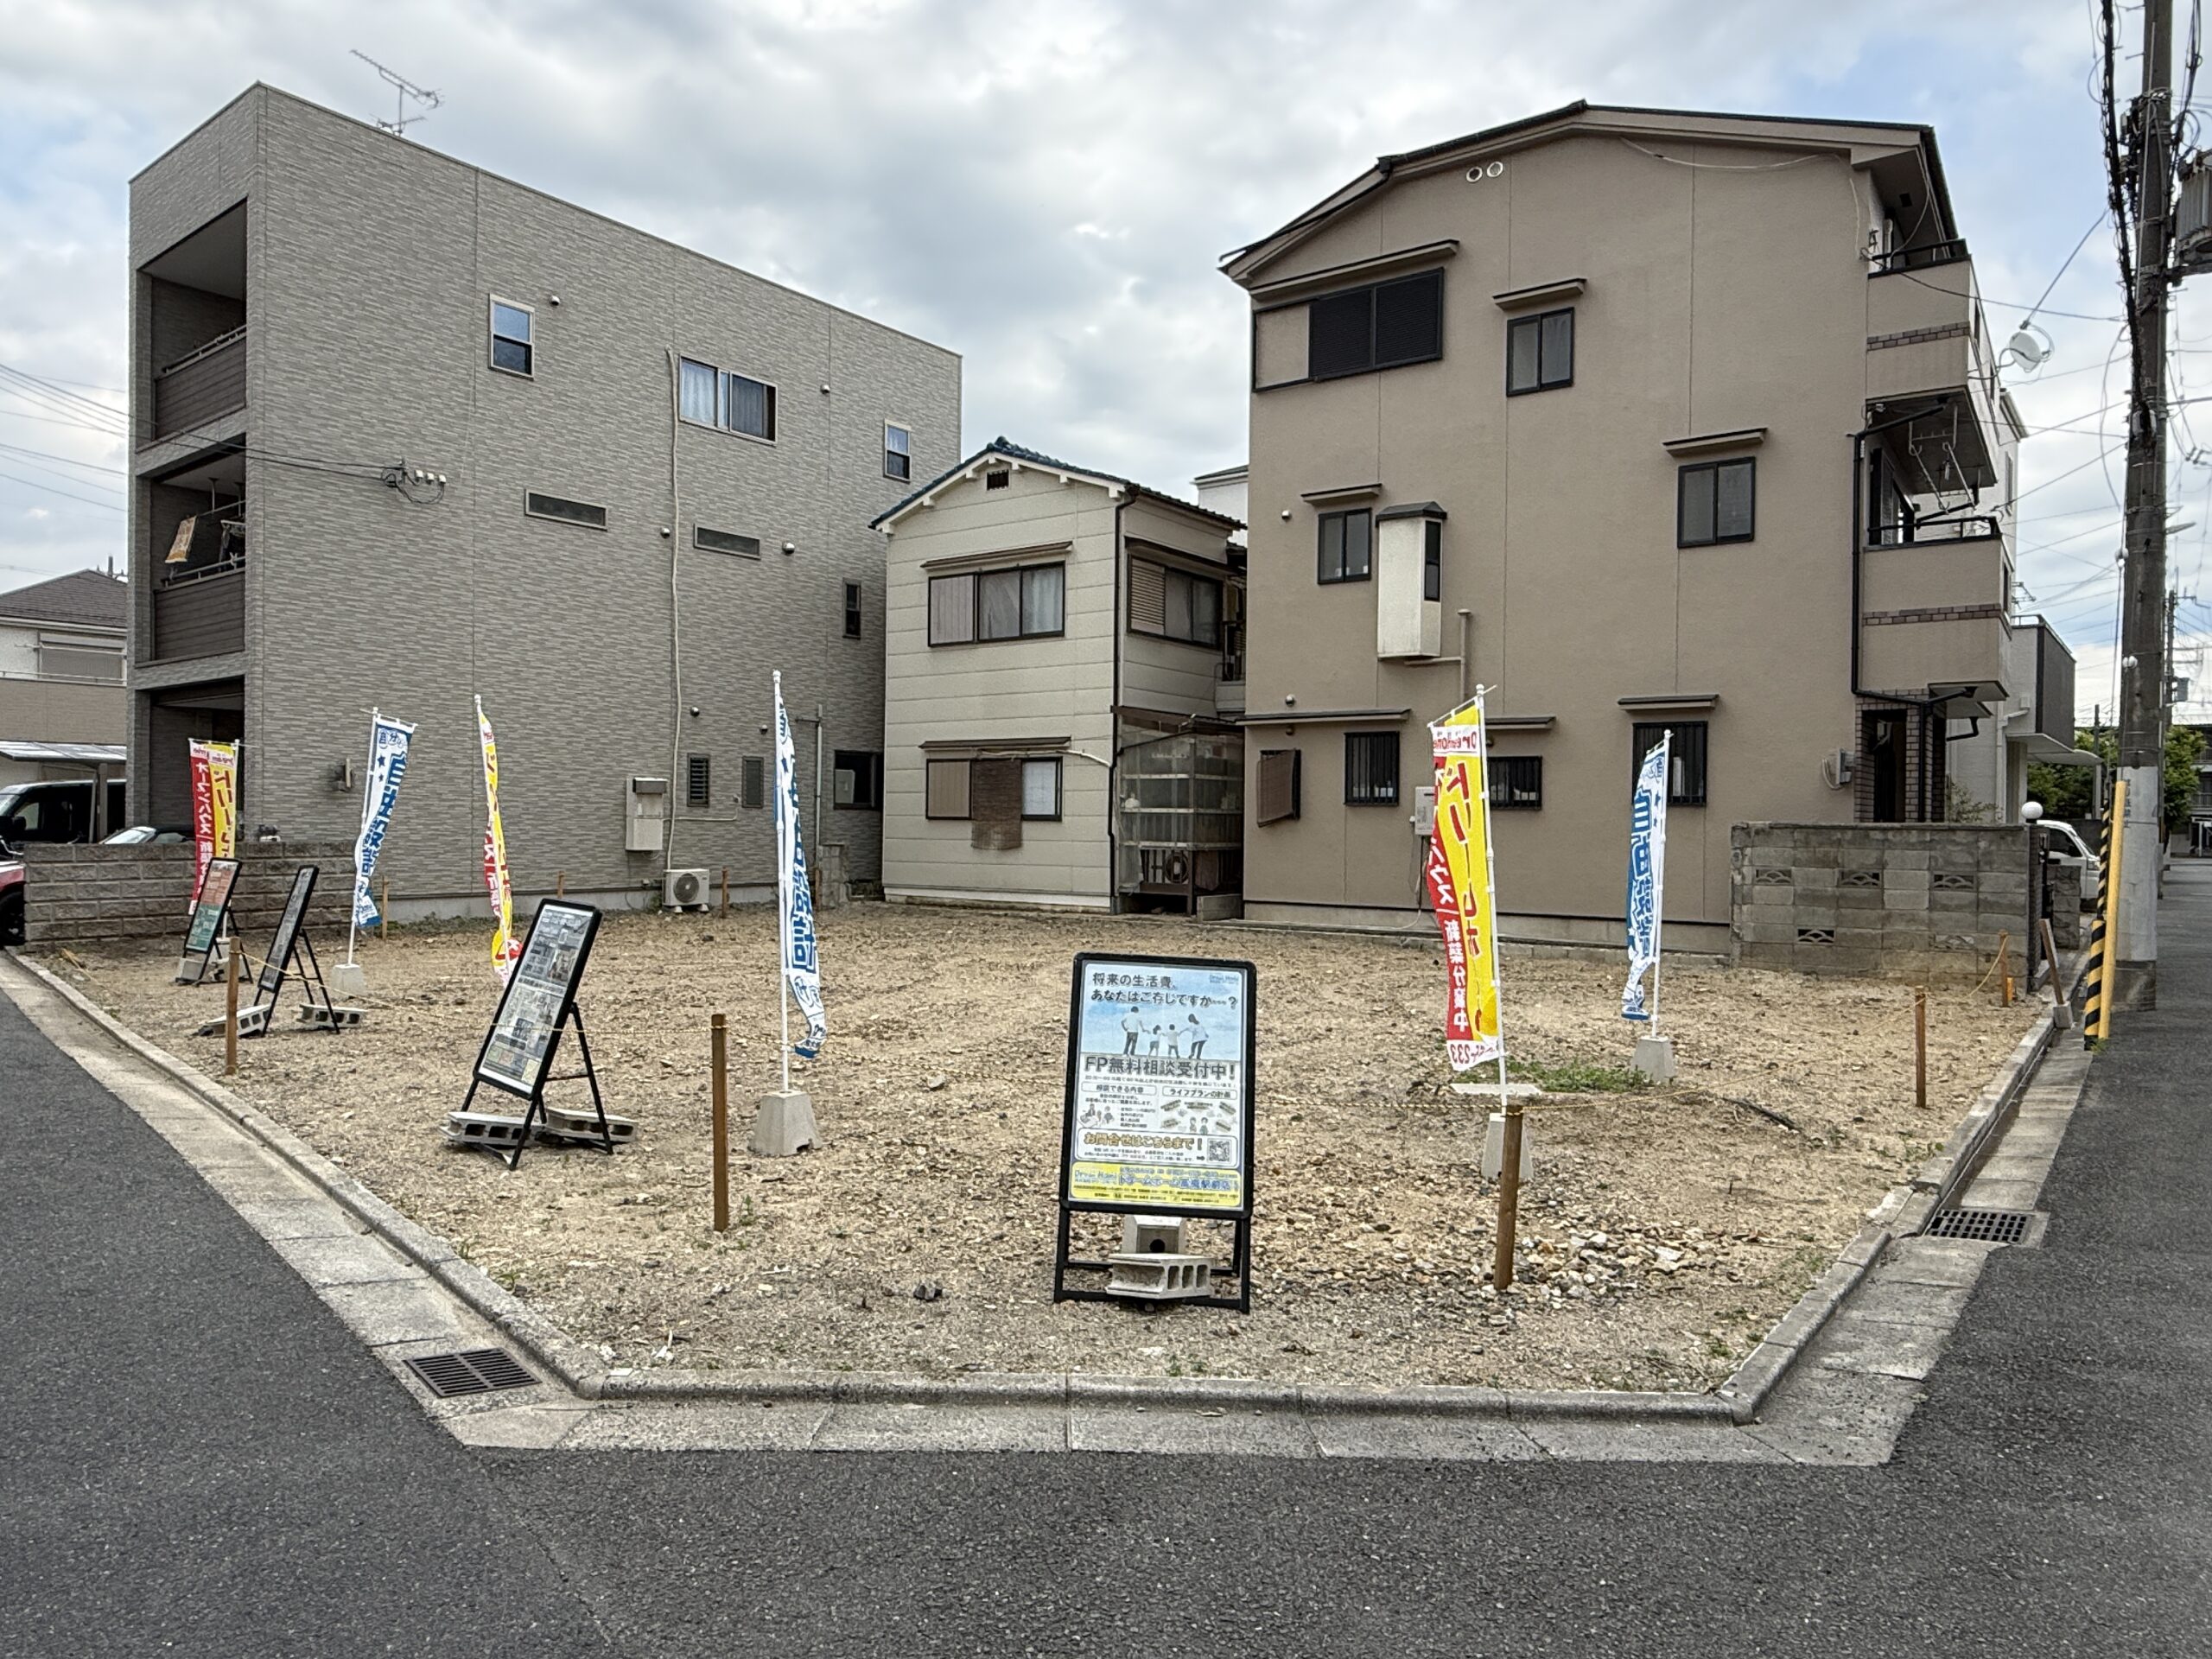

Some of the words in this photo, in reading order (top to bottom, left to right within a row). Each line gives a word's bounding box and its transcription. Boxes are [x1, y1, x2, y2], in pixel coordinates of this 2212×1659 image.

[1092, 972, 1176, 988] 将来の生活費、
[1084, 1056, 1236, 1080] FP無料相談受付中！
